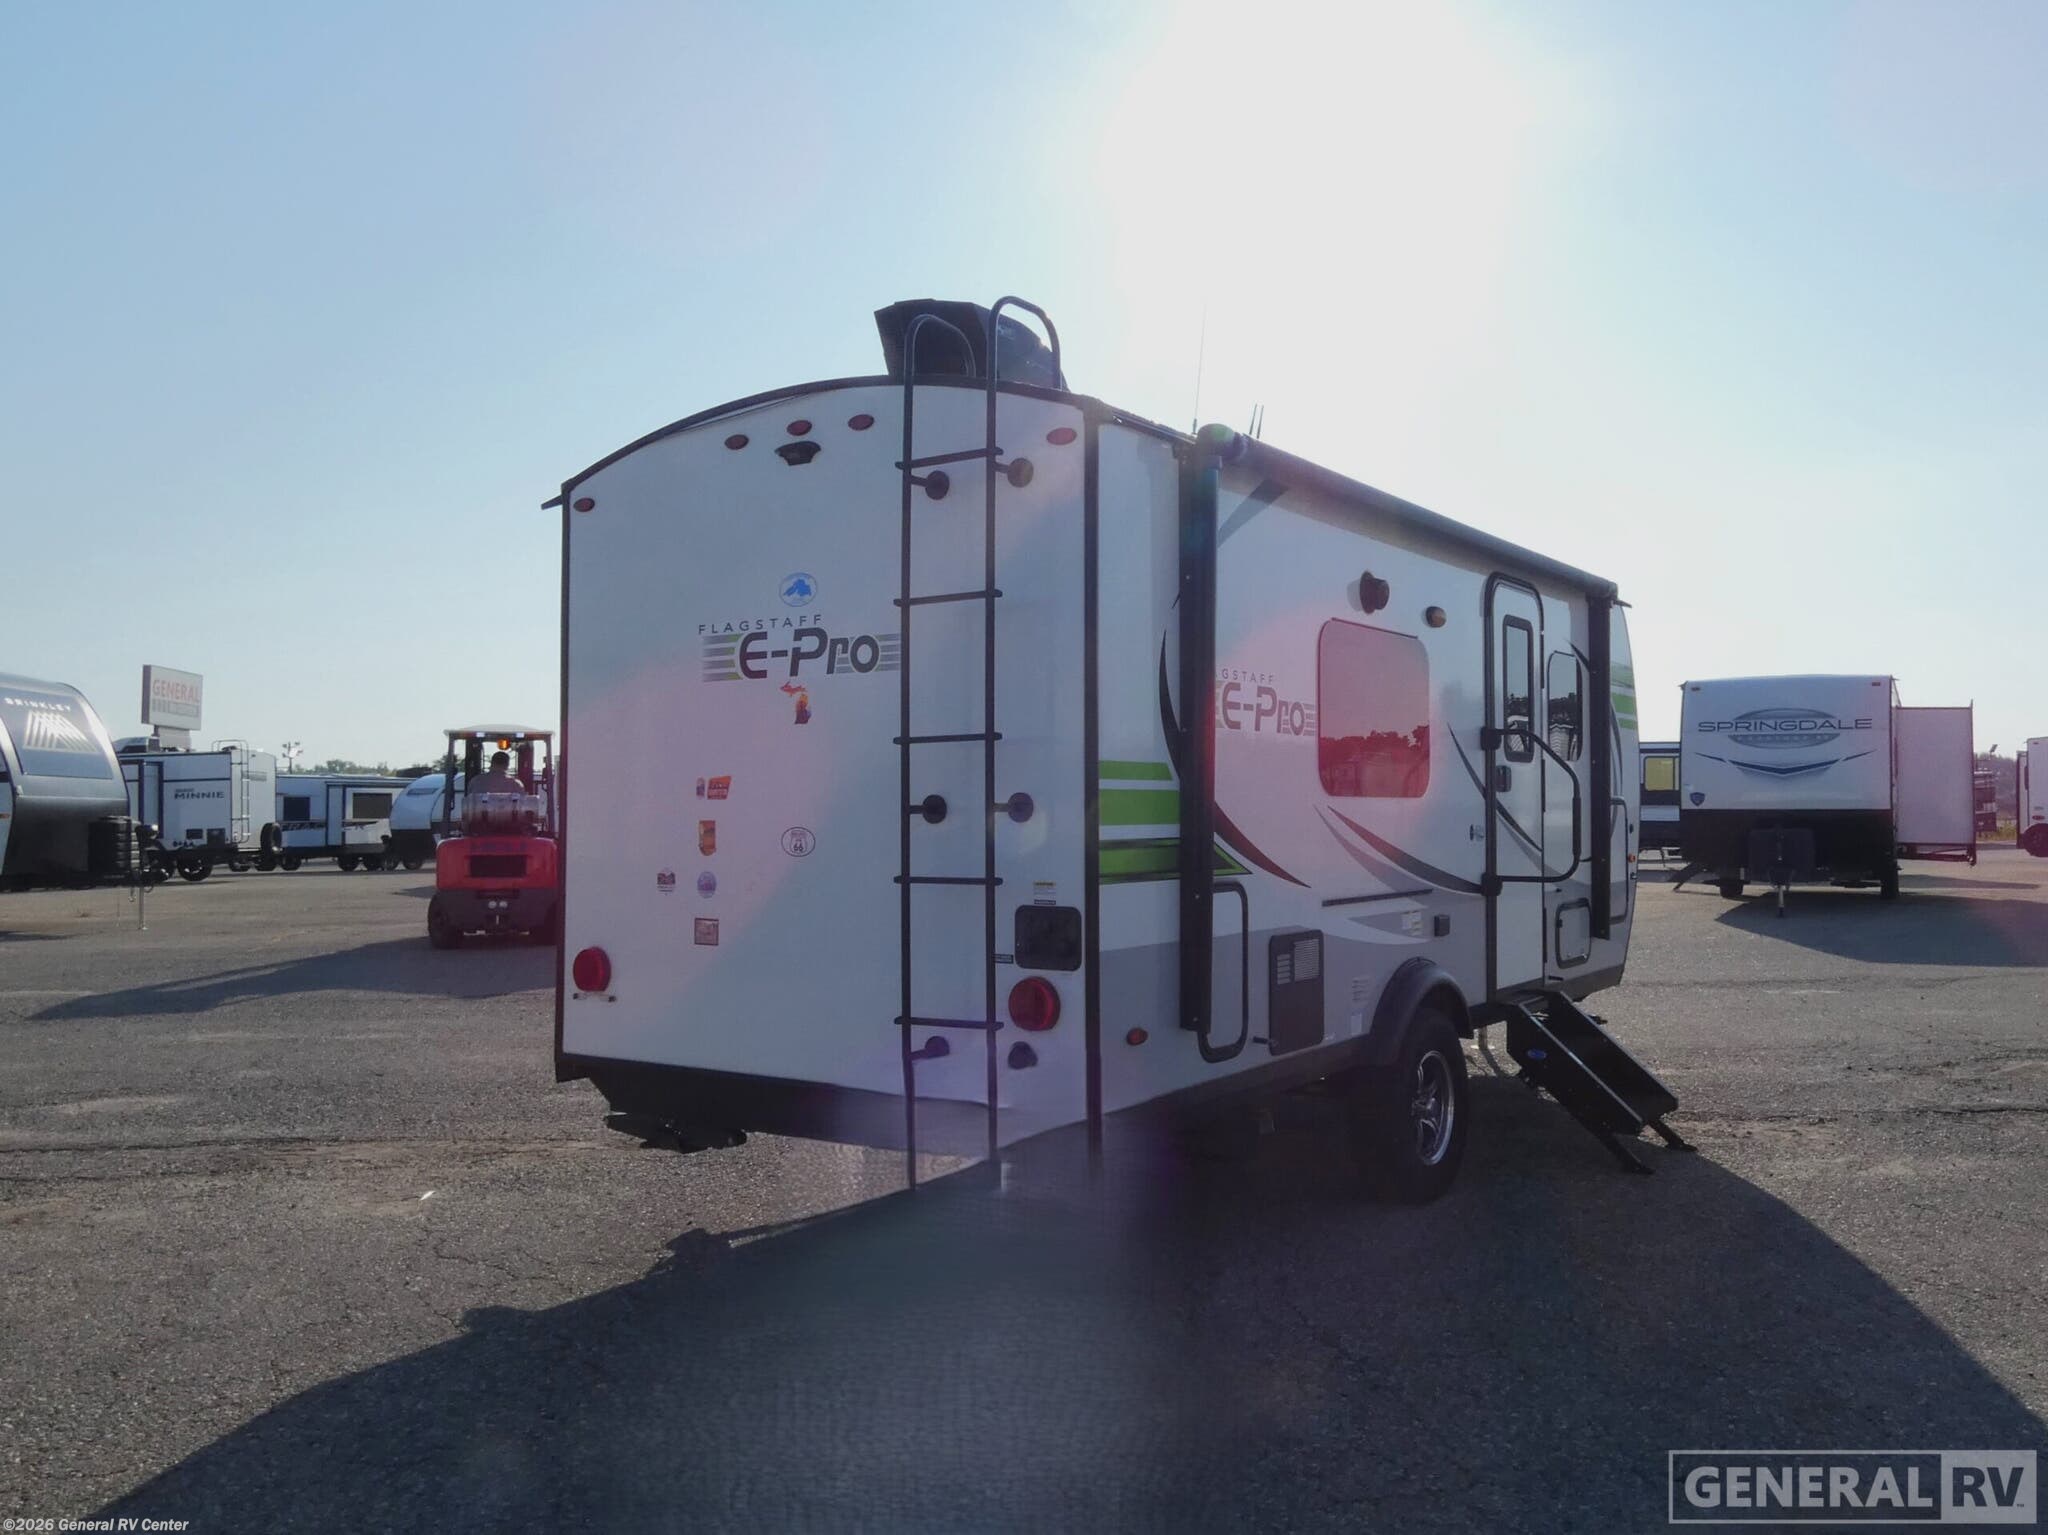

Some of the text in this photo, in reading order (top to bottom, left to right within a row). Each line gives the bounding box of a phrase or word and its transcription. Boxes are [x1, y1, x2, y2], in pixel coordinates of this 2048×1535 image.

[698, 614, 823, 635] FLAGSTAFF
[739, 627, 880, 680] E-Pro
[1216, 668, 1274, 685] GSTAFF
[152, 680, 200, 703] GENERAL
[4, 697, 71, 711] BRINKLEY
[1222, 682, 1305, 736] E-Pro
[1697, 718, 1873, 733] SPRINGDALE
[174, 791, 225, 800] MINNIE
